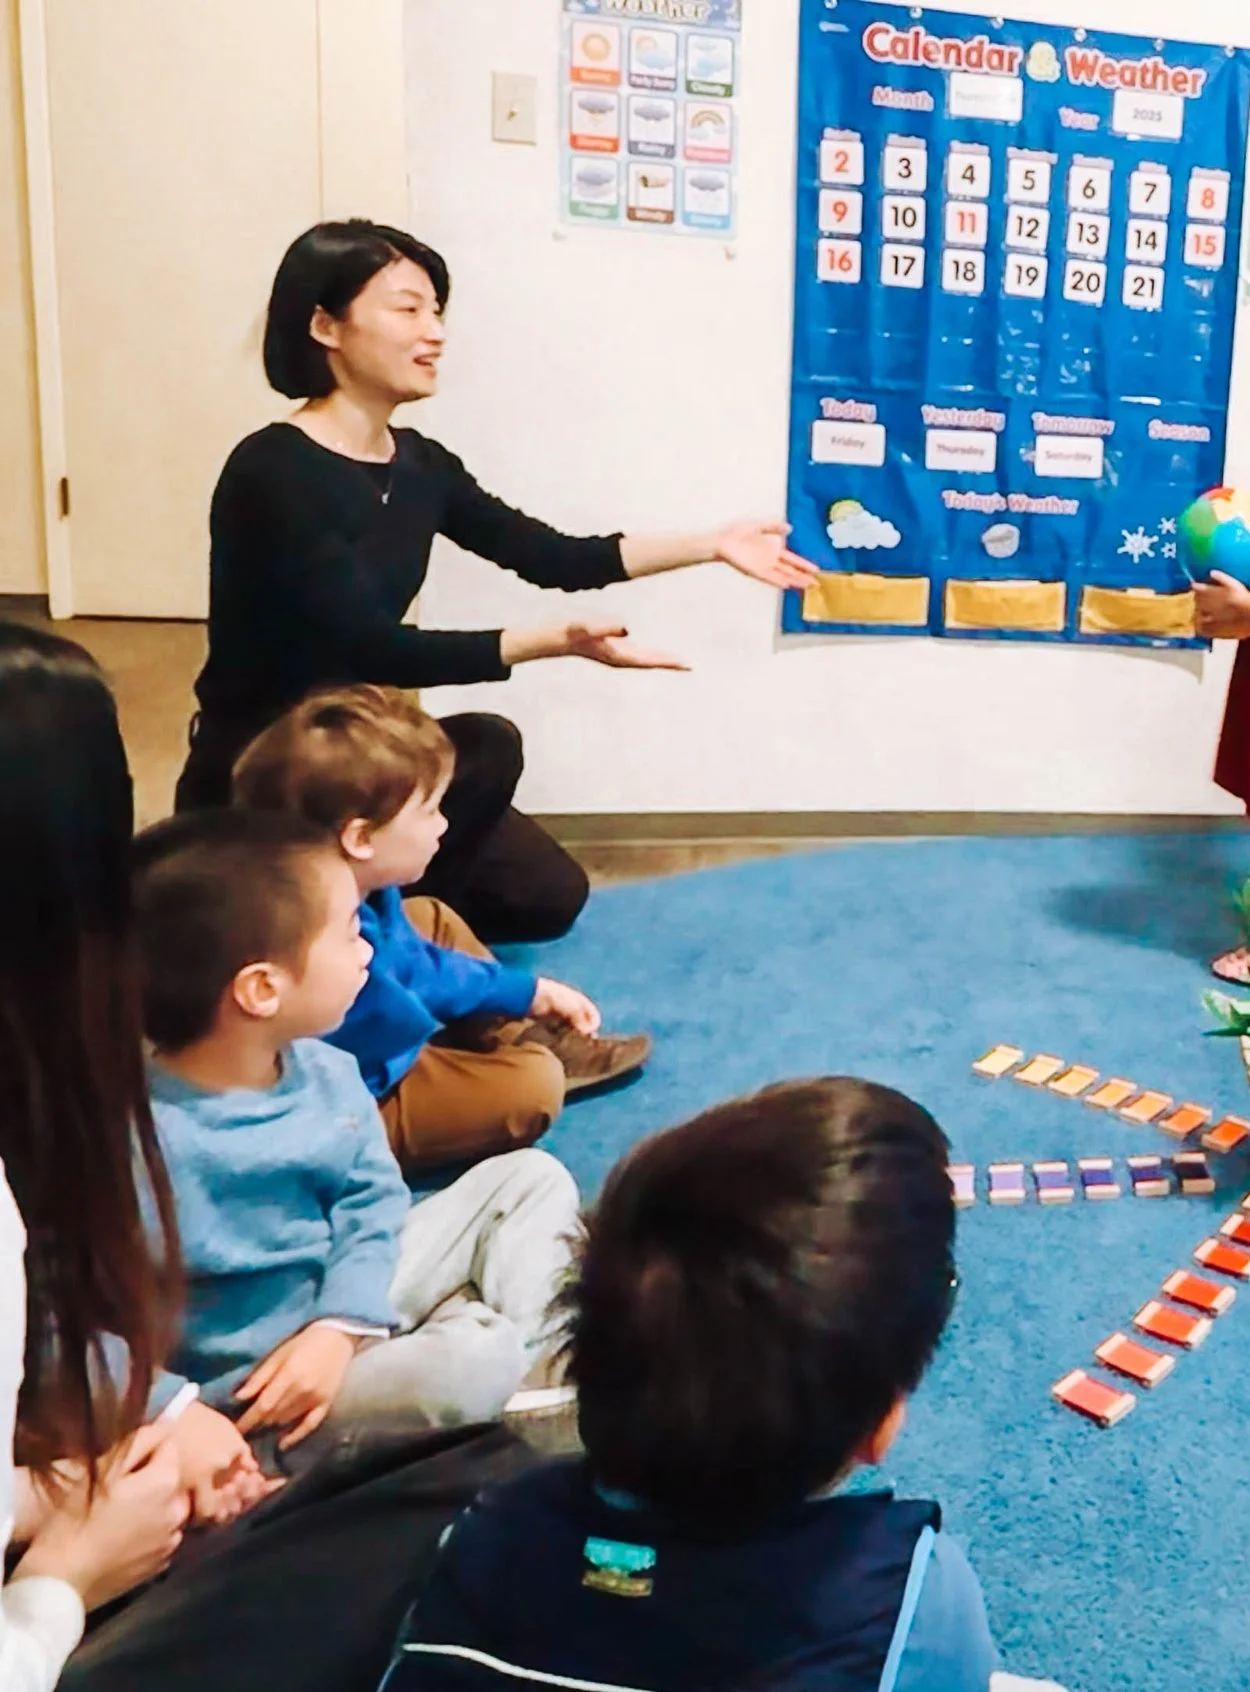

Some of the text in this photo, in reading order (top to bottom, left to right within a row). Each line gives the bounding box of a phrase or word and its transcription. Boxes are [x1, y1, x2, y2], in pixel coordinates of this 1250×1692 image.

[865, 24, 1021, 74] Calendar
[1067, 48, 1205, 96] Weather
[873, 87, 933, 110] Month
[1059, 107, 1099, 130] Year
[1132, 108, 1164, 122] 2025
[835, 151, 1215, 209] 2 3 4 5 6 7 8
[832, 201, 1217, 256] 9 10 11 12 13 14 15
[828, 250, 1156, 298] 16 17 18 19 20 21
[820, 398, 877, 423] Today
[921, 404, 1006, 432] Yesterday
[1031, 412, 1115, 435] Tomorrow
[1007, 493, 1080, 515] Weather
